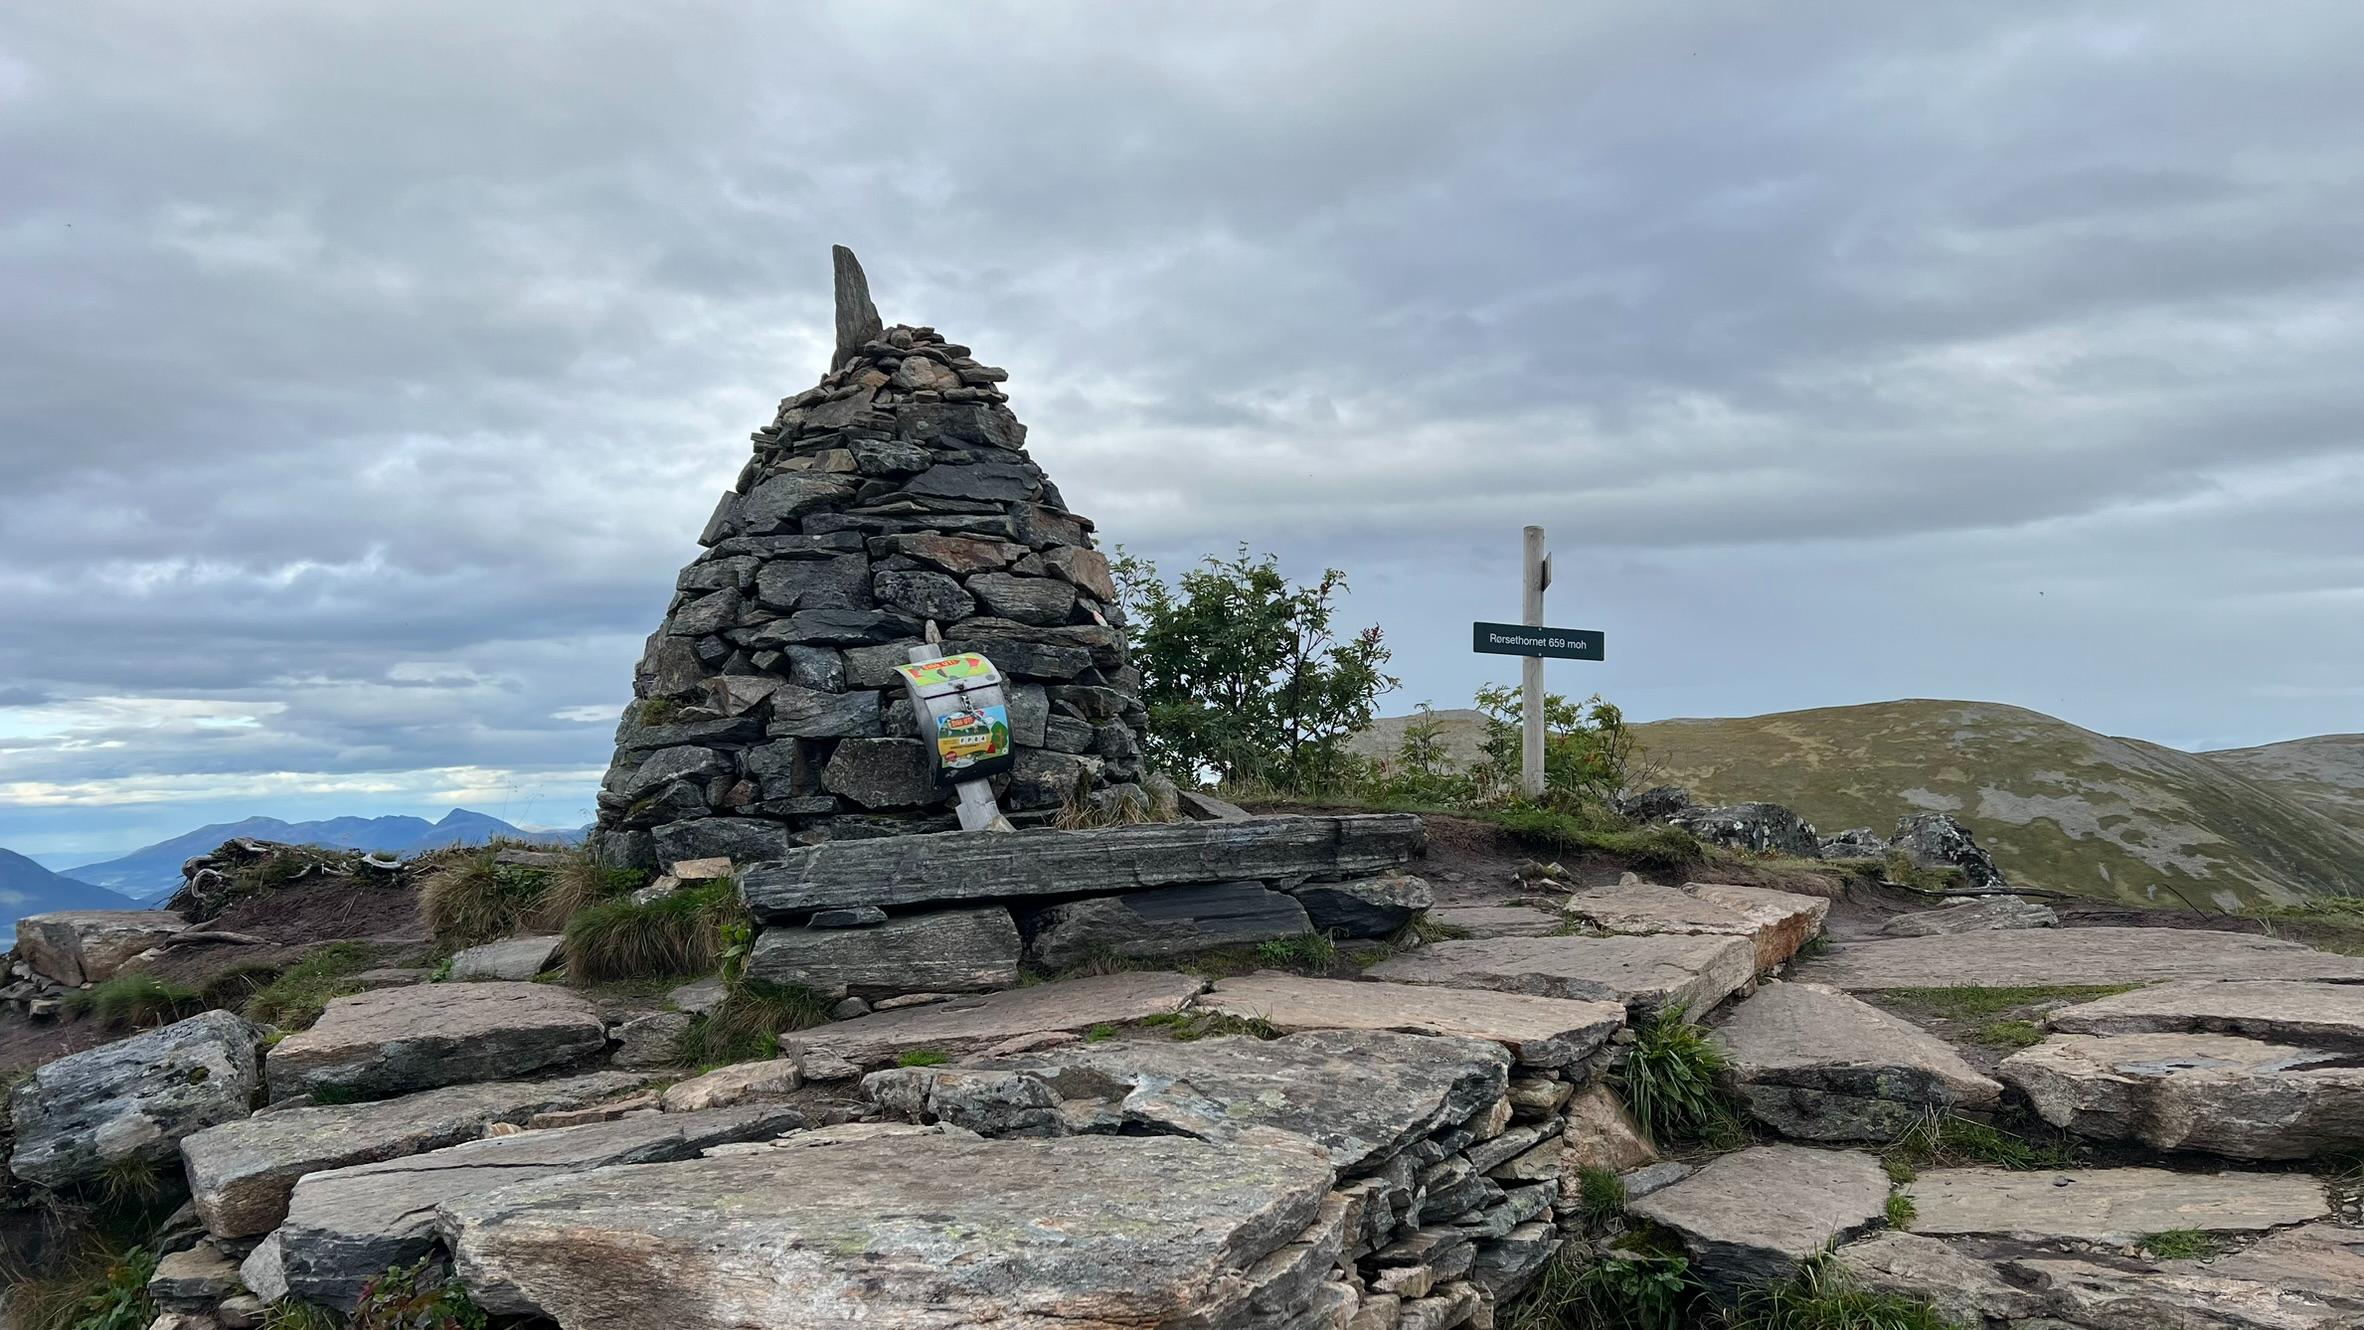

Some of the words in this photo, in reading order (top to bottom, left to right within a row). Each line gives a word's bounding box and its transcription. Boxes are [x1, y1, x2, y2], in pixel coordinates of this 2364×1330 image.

[1489, 633, 1546, 647] Rørsethornet
[1548, 638, 1565, 648] 659
[1567, 640, 1587, 650] moh
